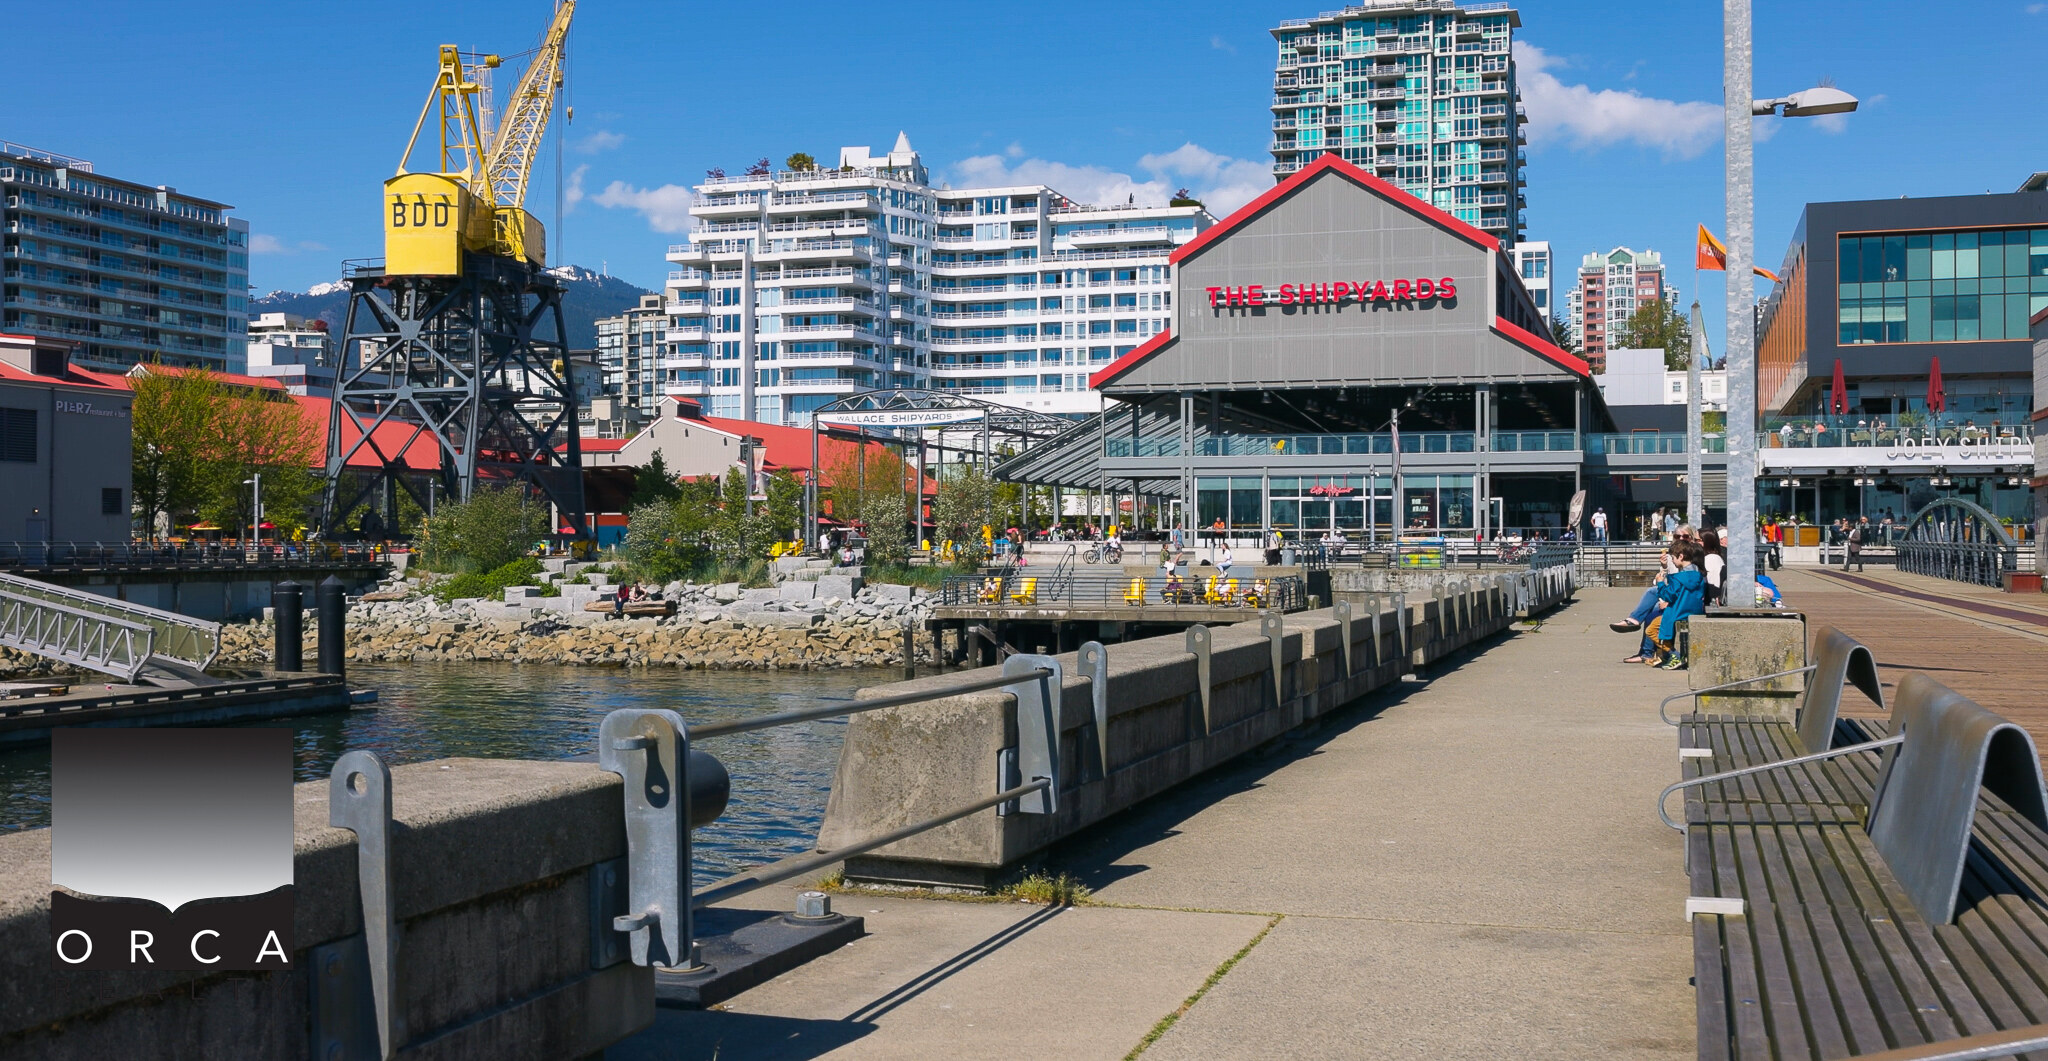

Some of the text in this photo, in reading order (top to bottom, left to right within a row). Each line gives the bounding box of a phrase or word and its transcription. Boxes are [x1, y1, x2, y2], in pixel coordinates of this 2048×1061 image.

[393, 202, 449, 227] BDD
[1206, 277, 1457, 307] THE SHIPYARDS
[836, 415, 885, 423] WALLACE
[891, 413, 953, 423] SHIPYARDS
[1887, 437, 1949, 458] JOEY
